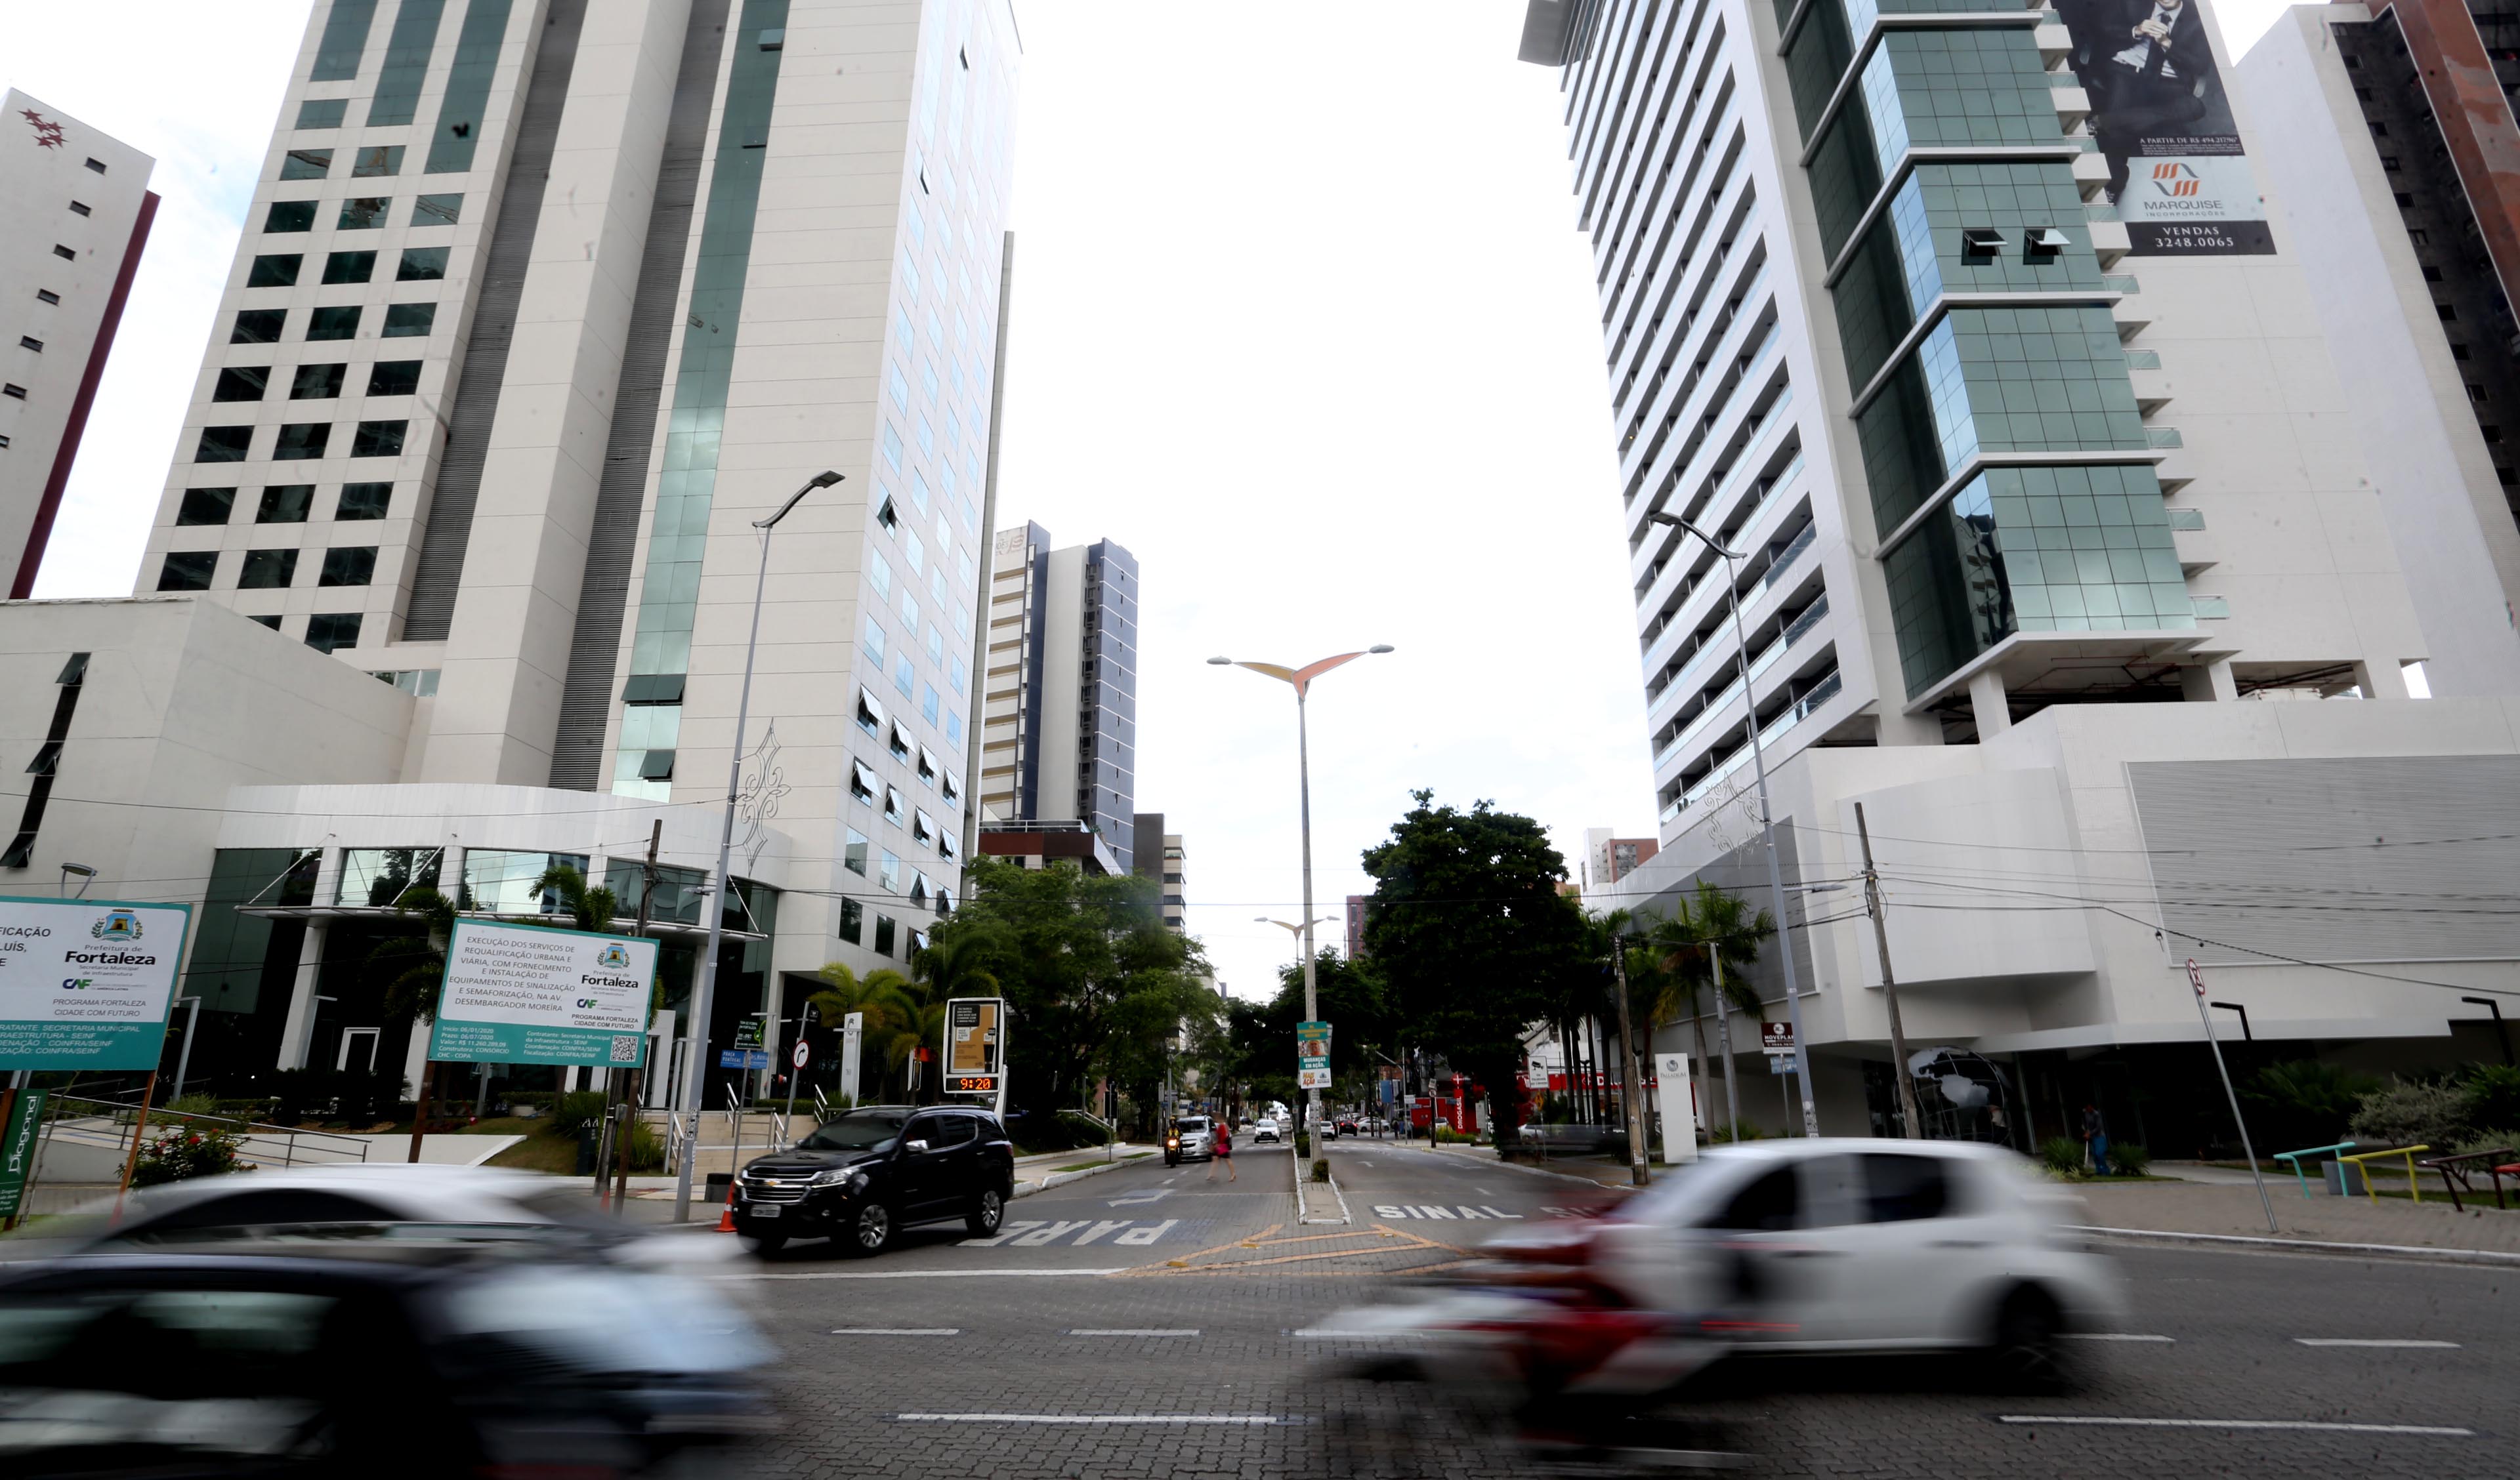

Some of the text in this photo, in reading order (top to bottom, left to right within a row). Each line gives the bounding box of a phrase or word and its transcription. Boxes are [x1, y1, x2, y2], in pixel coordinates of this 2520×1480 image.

[2144, 200, 2223, 210] MARQUISE
[2163, 226, 2219, 235] VENDAS
[2155, 237, 2234, 247] 3248.0065
[467, 936, 509, 946] EXECUÇÃO
[529, 942, 563, 952] SERVIÇOS
[65, 951, 156, 965] Fortaleza
[464, 947, 532, 959] REQUALIFICAÇÃO
[534, 953, 565, 962] URBANA
[488, 968, 537, 979] INSTALAÇÃO
[513, 962, 572, 973] FORNECIMENTO
[62, 979, 93, 989] CAF
[449, 976, 513, 987] EQUIPAMENTOS
[526, 981, 576, 993] SINALIZAÇÃO
[581, 974, 639, 989] Fortaleza
[466, 987, 534, 1000] SEMAFORIZAÇÃO,
[455, 997, 526, 1010] DESEMBARGADOR
[577, 998, 598, 1009] CAF
[961, 1079, 990, 1089] 9:20
[9, 1096, 37, 1172] Diagonal
[1374, 1206, 1524, 1219] SINAL
